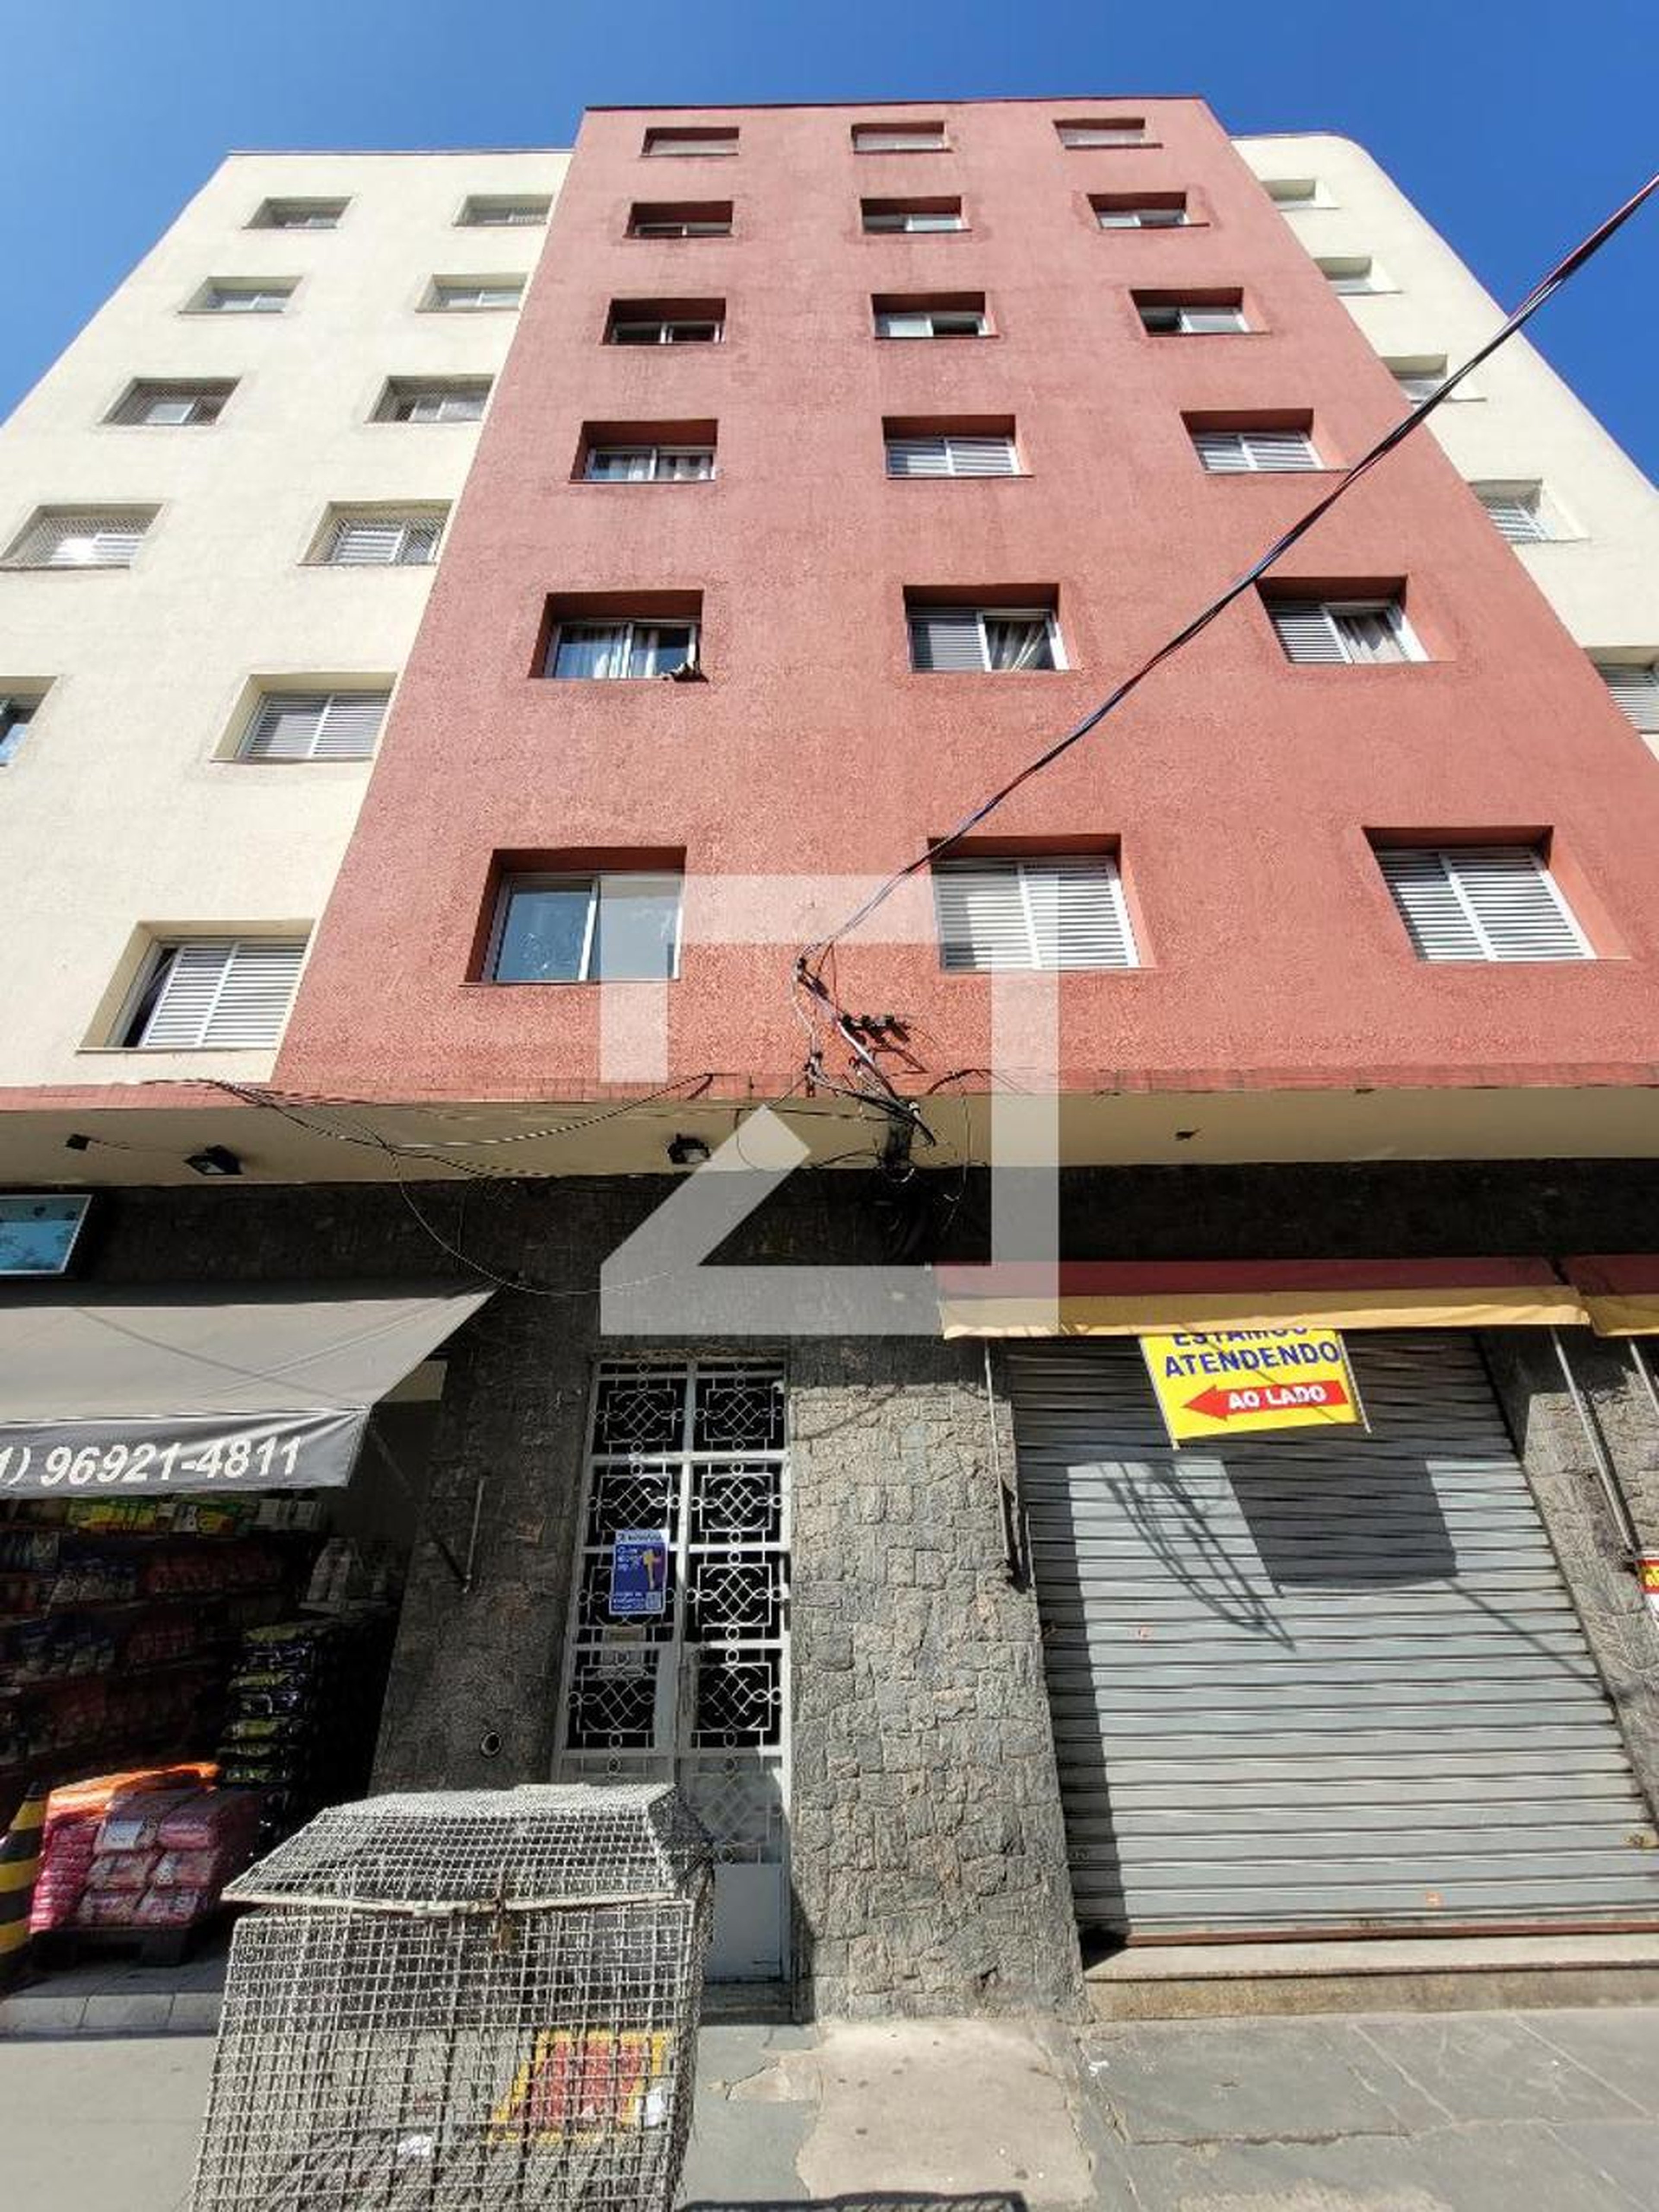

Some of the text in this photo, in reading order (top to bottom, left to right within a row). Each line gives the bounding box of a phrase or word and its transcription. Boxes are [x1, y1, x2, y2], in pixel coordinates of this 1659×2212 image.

[1166, 1341, 1340, 1377] ATENDENDO
[1228, 1385, 1327, 1410] AO LADO
[41, 1436, 301, 1486] 96921-4811
